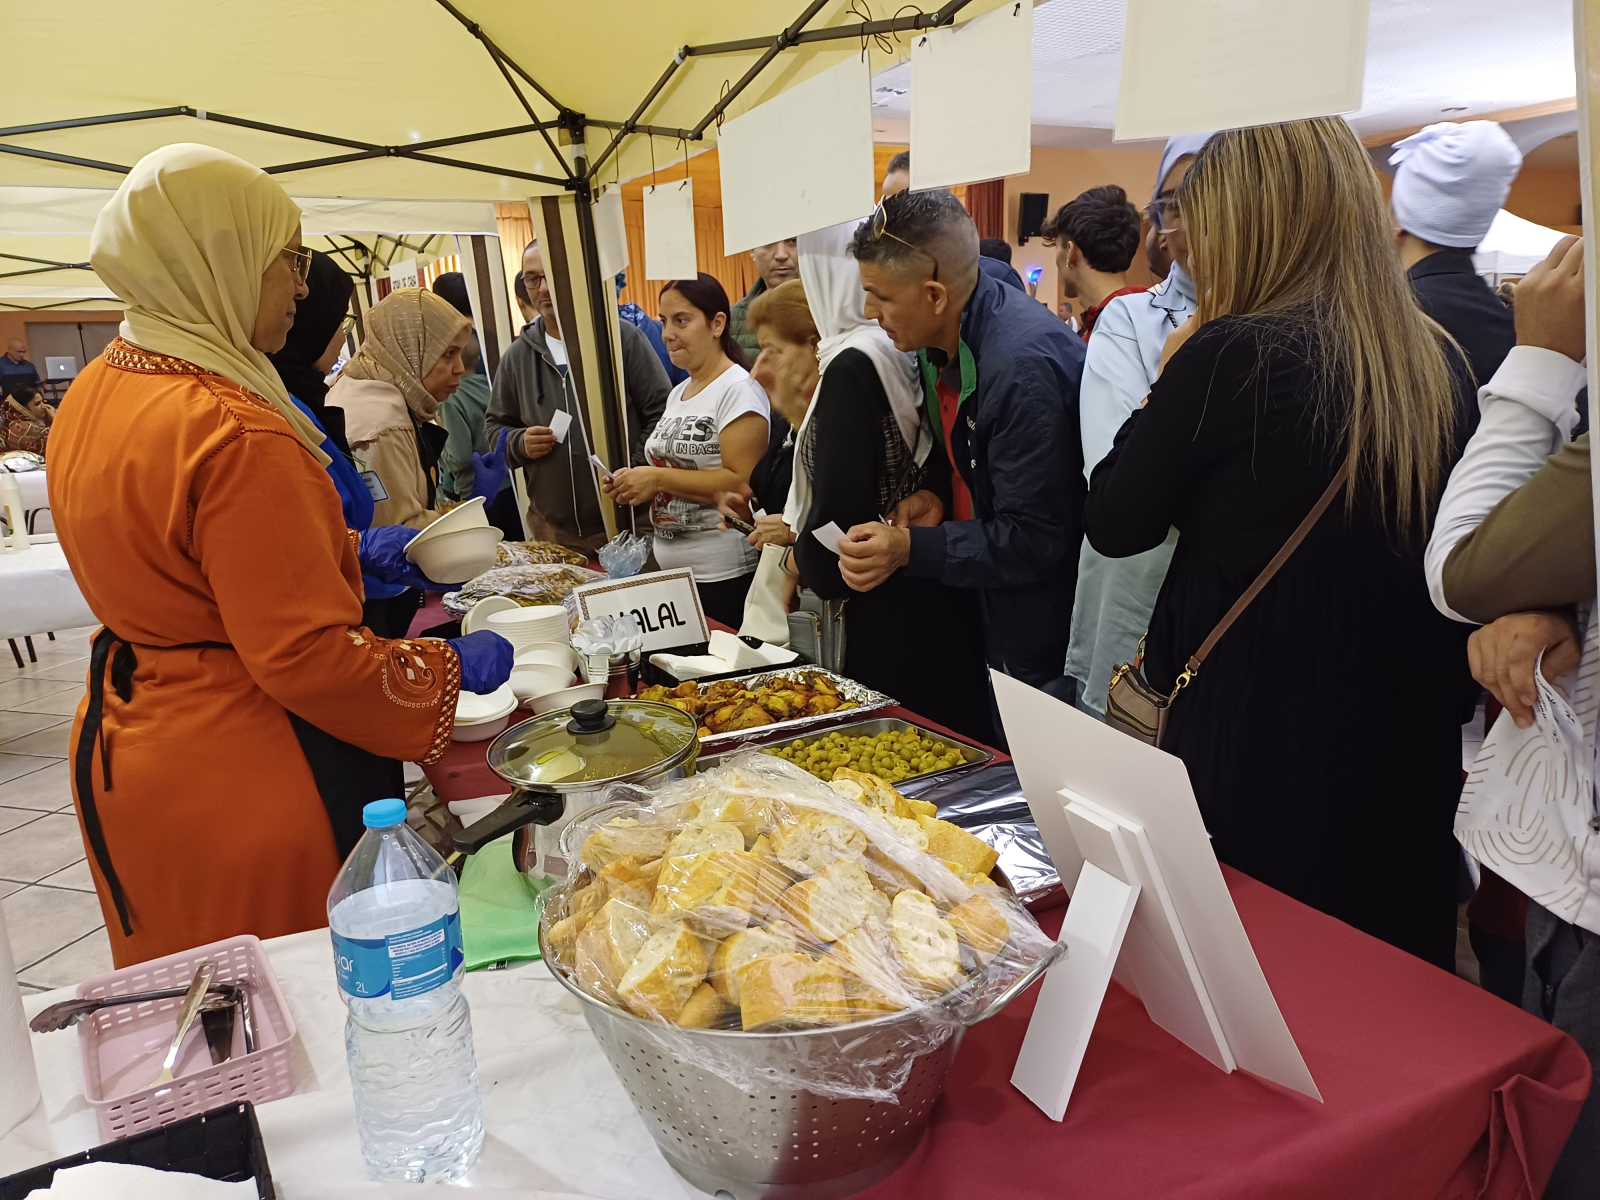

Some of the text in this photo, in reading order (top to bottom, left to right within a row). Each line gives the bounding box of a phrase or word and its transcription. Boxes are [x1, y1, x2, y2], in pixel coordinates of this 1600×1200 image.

[676, 442, 688, 454] IN
[609, 601, 687, 633] ALAL
[355, 981, 369, 994] 2L
